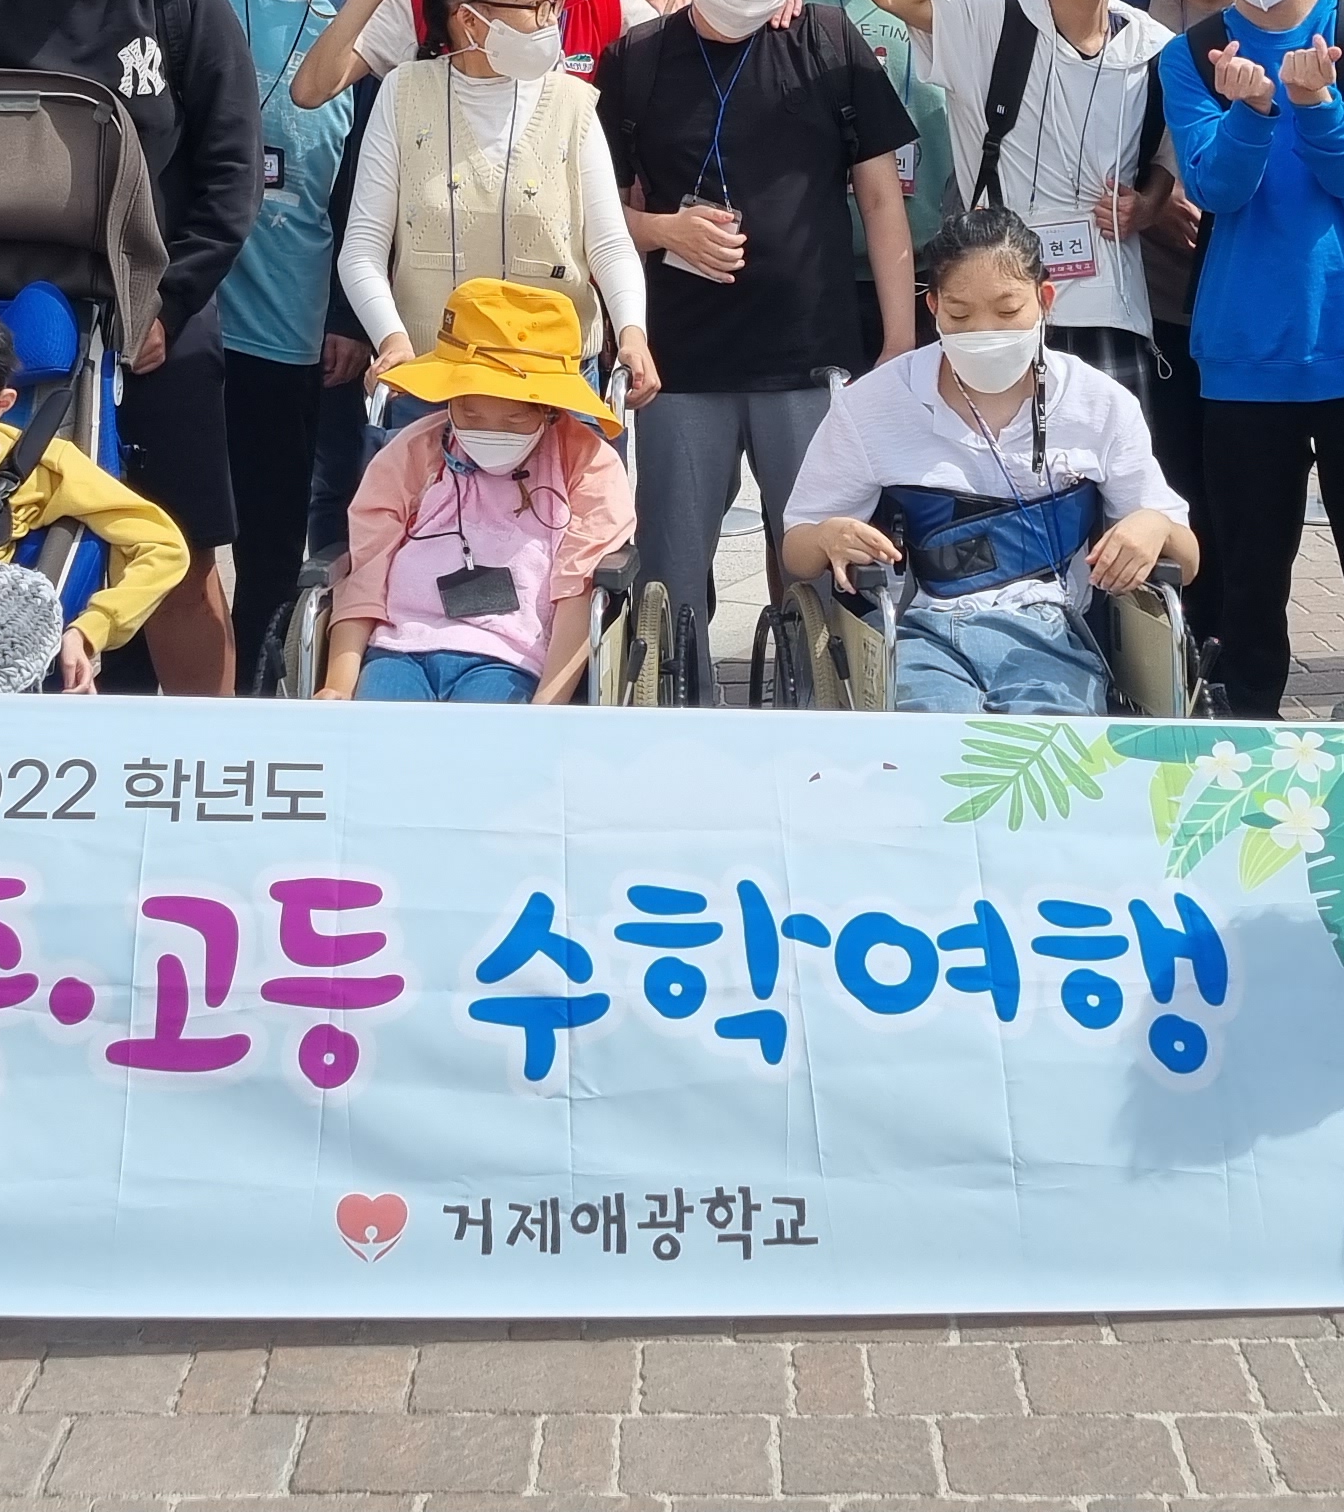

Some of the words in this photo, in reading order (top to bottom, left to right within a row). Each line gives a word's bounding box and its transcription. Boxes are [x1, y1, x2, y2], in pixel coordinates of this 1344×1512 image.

[116, 35, 166, 98] NY
[124, 758, 328, 823] 학년도
[468, 883, 1228, 1080] 수학여행
[444, 1188, 819, 1263] 거제애광학교
